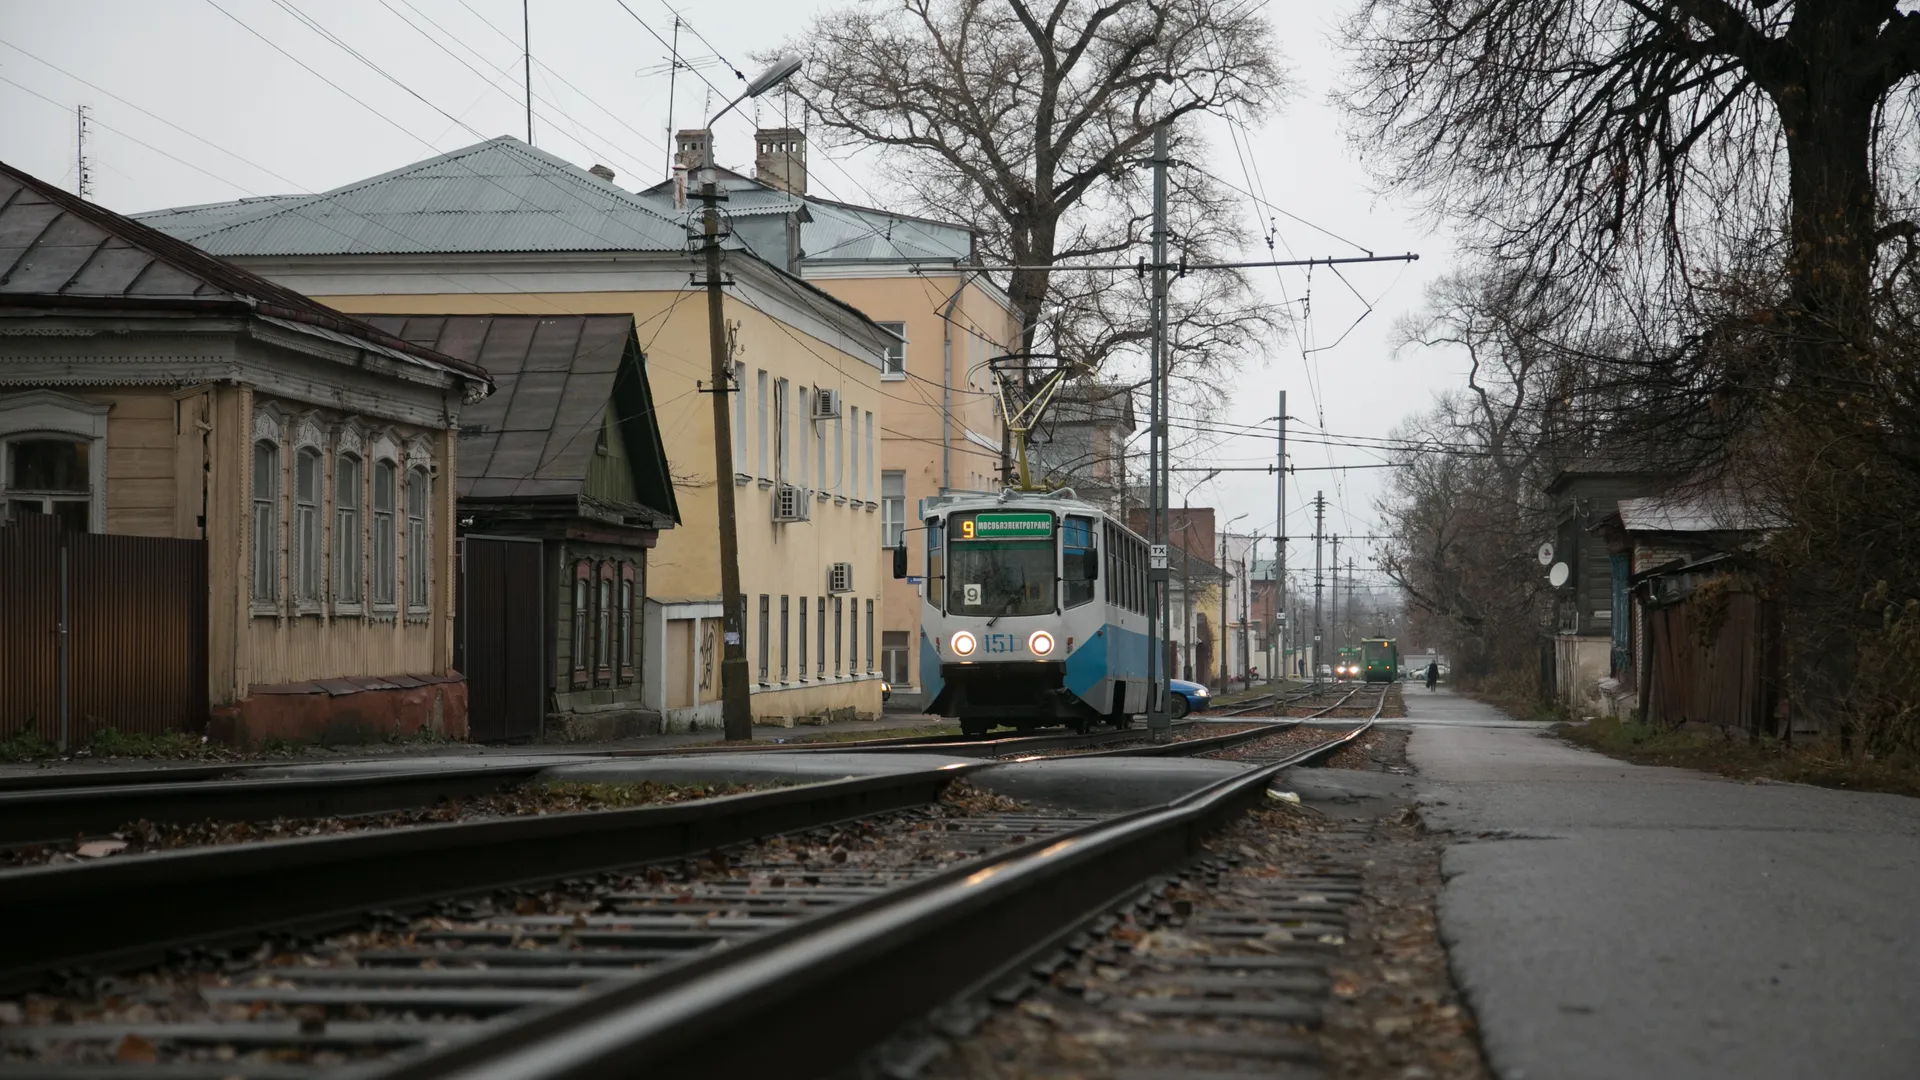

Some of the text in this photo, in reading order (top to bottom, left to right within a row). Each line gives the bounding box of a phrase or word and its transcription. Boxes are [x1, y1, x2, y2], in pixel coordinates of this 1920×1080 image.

[963, 520, 974, 538] 9
[978, 521, 1050, 530] МОСОБЛЭЛЕКТРОТРАНС
[966, 588, 978, 602] 9
[984, 633, 1014, 654] 151
